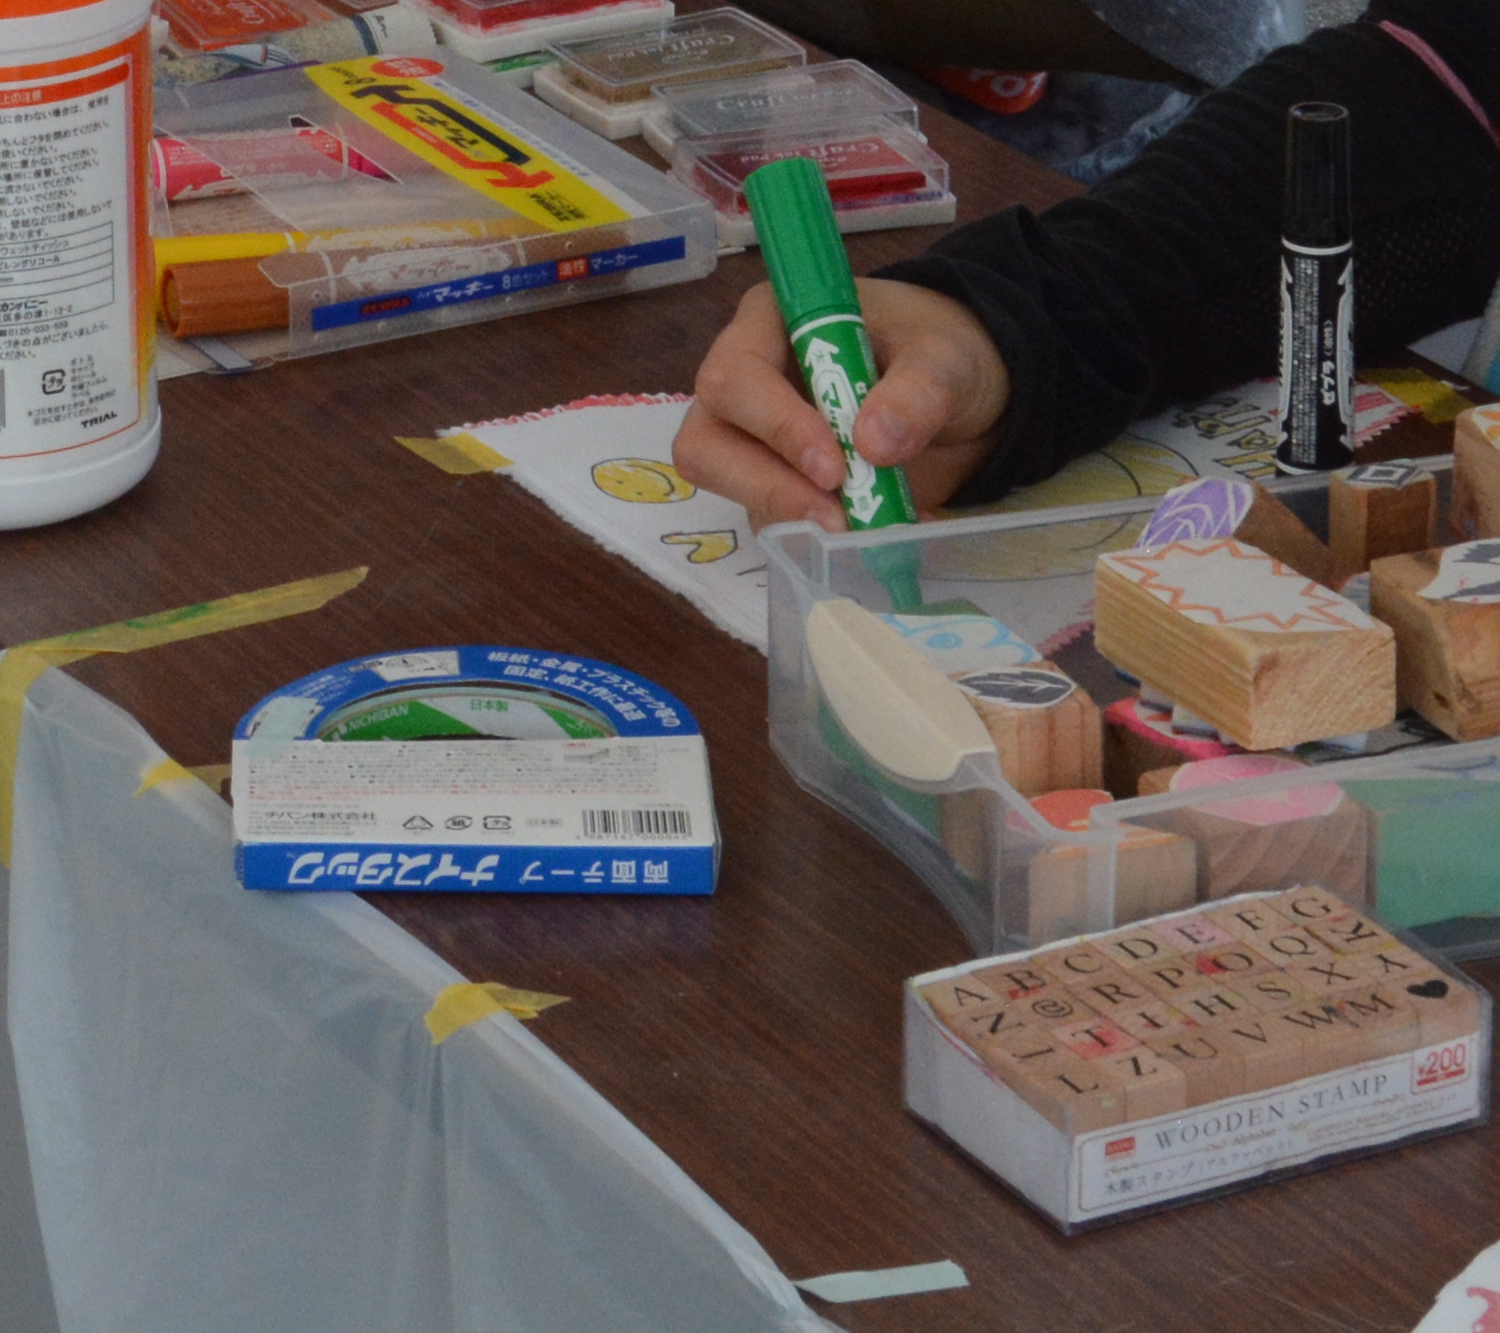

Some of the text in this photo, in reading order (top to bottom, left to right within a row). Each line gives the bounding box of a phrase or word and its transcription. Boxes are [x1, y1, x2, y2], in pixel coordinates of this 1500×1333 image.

[671, 34, 736, 52] Craft
[502, 268, 550, 290] 8色セット
[591, 251, 638, 270] マーカー
[80, 410, 118, 429] TRIAL
[469, 699, 509, 713] 日本製
[287, 851, 669, 886] 両面テープ ナイスタック
[953, 896, 1332, 1008] A B C D E F G
[1092, 982, 1132, 1006] R
[1152, 967, 1188, 989] P
[1211, 952, 1255, 975] O
[1269, 935, 1314, 962] Q
[1070, 1027, 1115, 1050] T
[1198, 994, 1238, 1018] H
[1255, 981, 1291, 1001] S
[1309, 963, 1354, 984] X
[1056, 1072, 1100, 1094] L
[1117, 1055, 1158, 1076] Z
[1172, 1040, 1219, 1060] U
[1231, 1024, 1270, 1045] V
[1155, 1103, 1285, 1151] WOODEN
[1298, 1073, 1389, 1116] STAMP
[1105, 1161, 1194, 1196] 木製スタンプ
